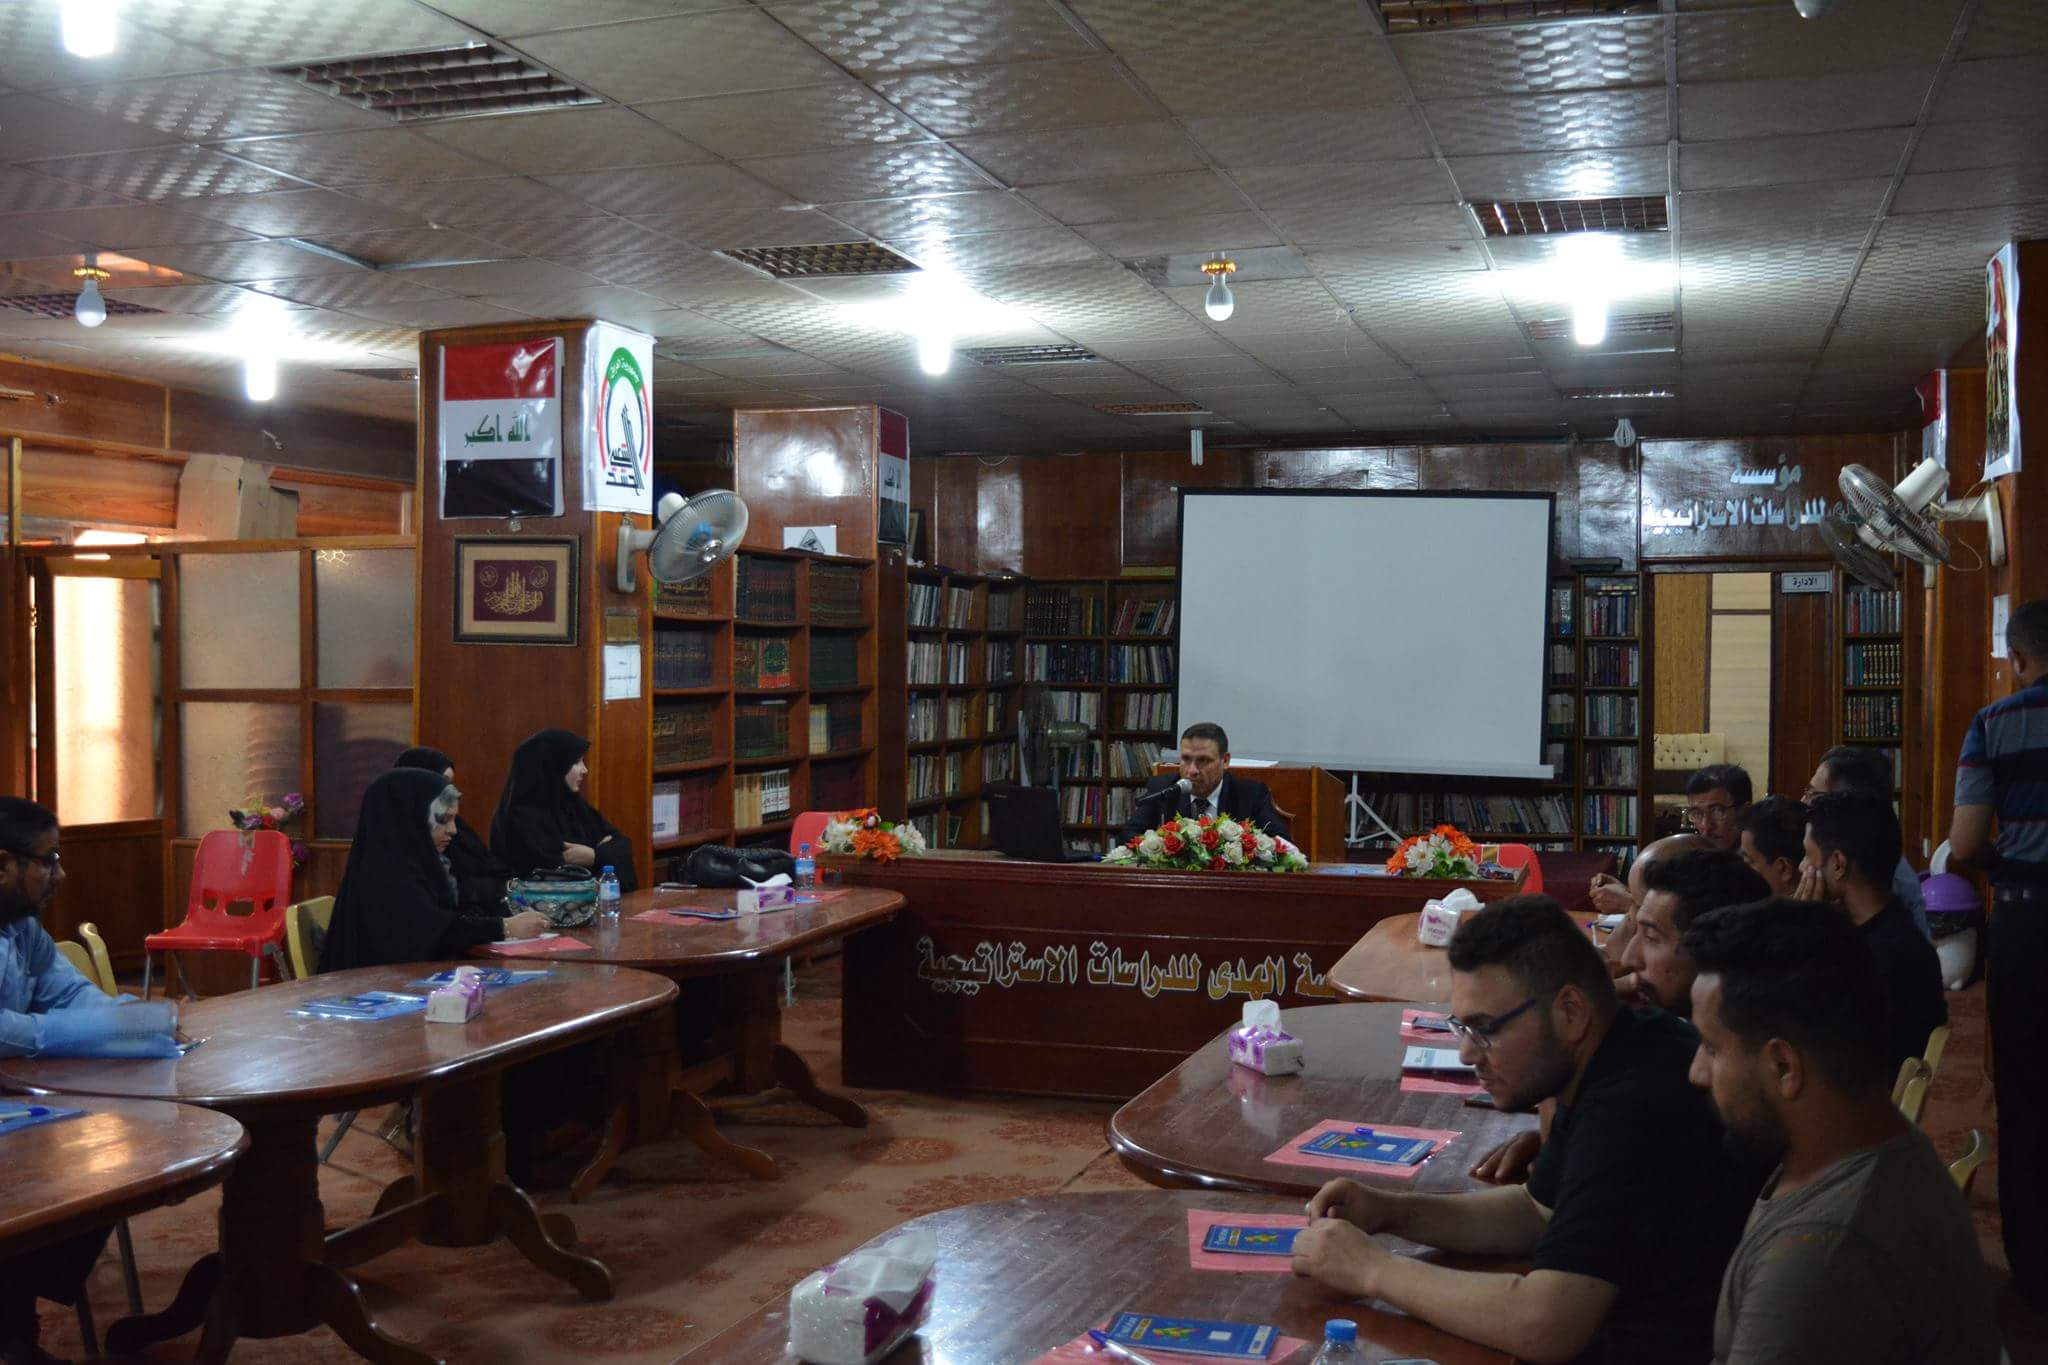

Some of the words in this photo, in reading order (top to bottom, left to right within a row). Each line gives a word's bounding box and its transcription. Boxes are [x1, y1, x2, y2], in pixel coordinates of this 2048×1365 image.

[1730, 454, 1802, 491] مؤسسة
[1641, 497, 1747, 536] الاستراتيجية
[1750, 496, 1827, 532] للدراسات
[916, 936, 1079, 996] الاستراتيجية
[1087, 940, 1202, 998] للدراسات
